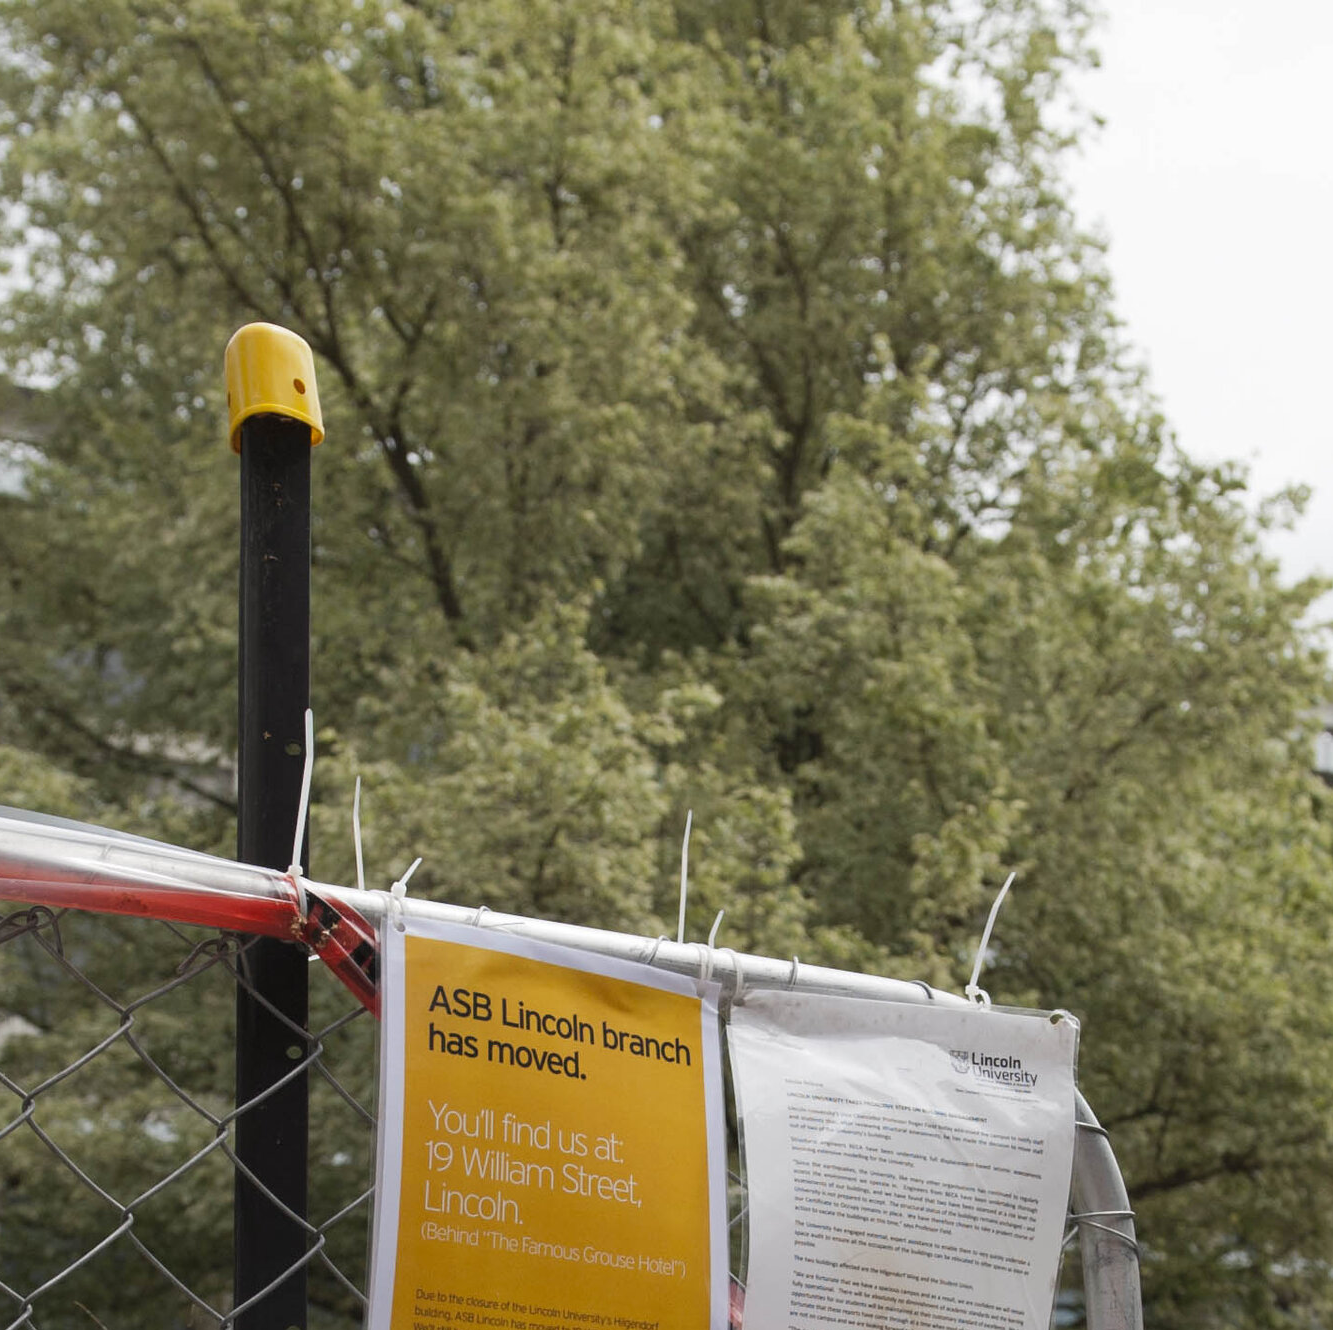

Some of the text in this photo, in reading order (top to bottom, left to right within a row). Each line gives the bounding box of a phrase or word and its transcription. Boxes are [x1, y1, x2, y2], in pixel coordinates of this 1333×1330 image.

[427, 1022, 586, 1081] has moved.
[428, 982, 690, 1066] ASB Lincoln branch
[971, 1051, 1021, 1069] Lincoln
[972, 1065, 1038, 1086] University
[426, 1098, 624, 1164] You'll find us at:
[424, 1138, 641, 1208] 19 William Street,
[423, 1179, 524, 1225] Lincoln.
[420, 1219, 479, 1248] (Behind
[522, 1236, 580, 1261] Famous
[583, 1245, 635, 1270] Grouse
